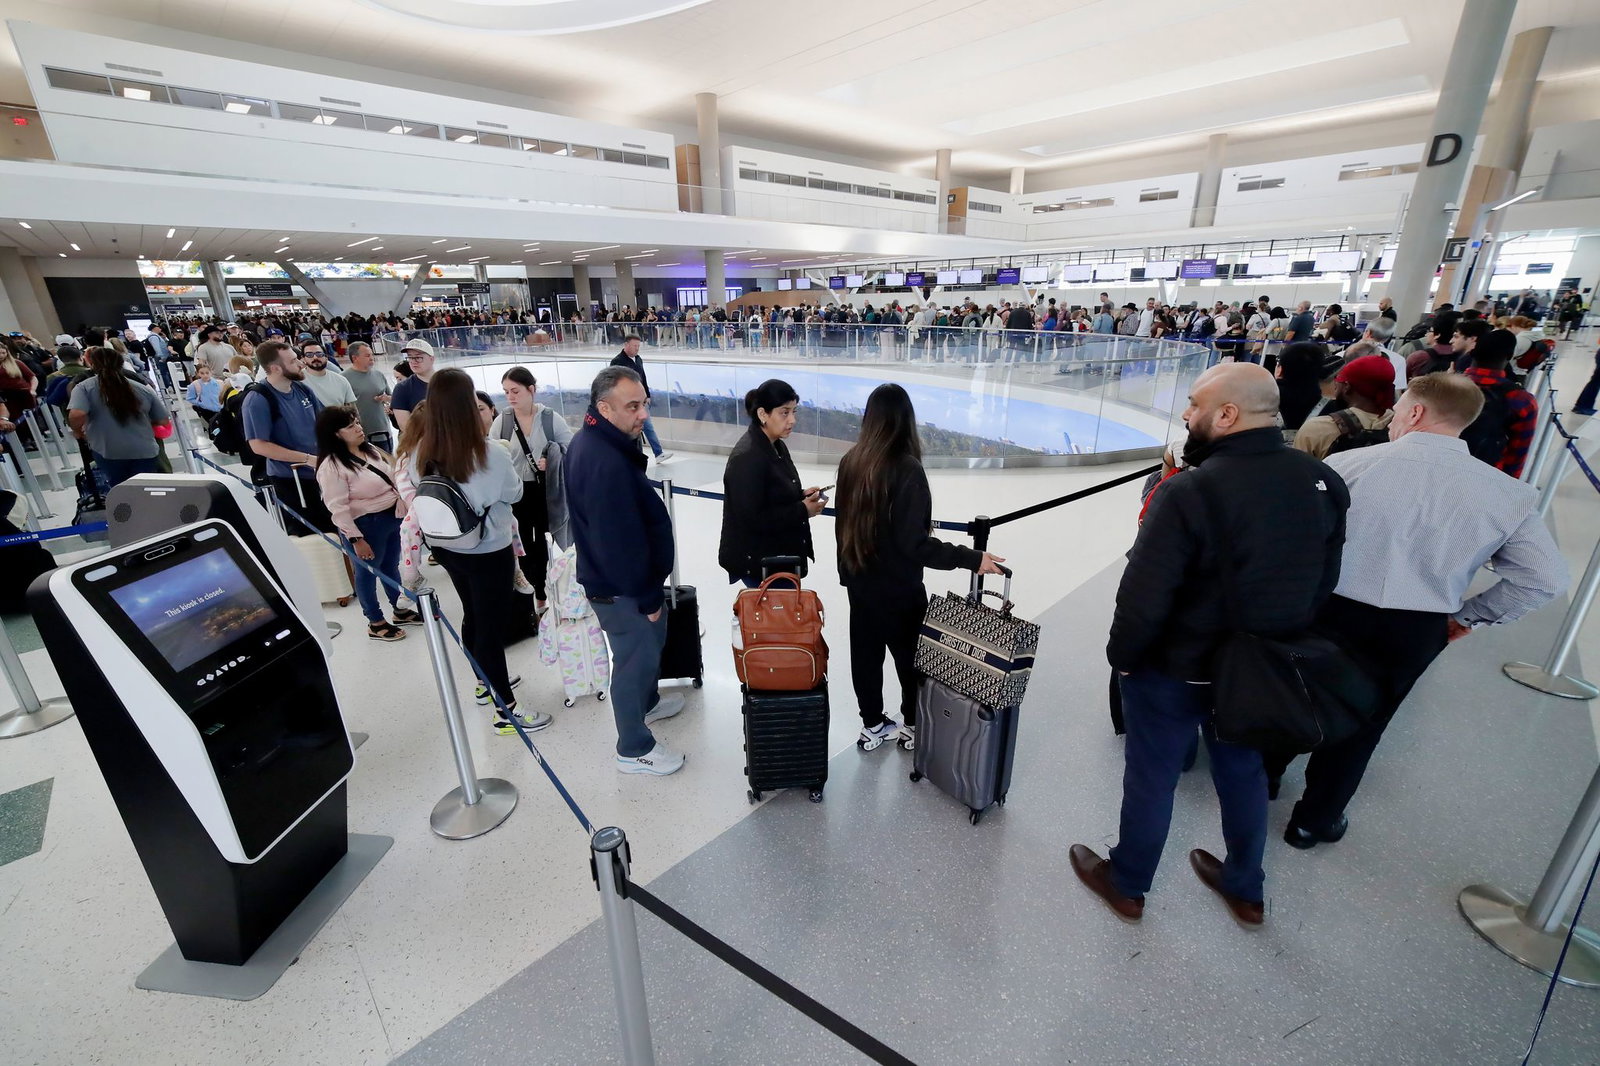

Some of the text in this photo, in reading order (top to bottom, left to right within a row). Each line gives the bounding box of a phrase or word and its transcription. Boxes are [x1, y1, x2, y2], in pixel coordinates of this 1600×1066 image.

[1426, 133, 1462, 167] D
[164, 606, 181, 618] This
[180, 599, 198, 611] kiosk
[204, 587, 225, 600] closed.
[940, 633, 987, 661] CHRISTIAN DIOR
[635, 757, 654, 766] HOKA
